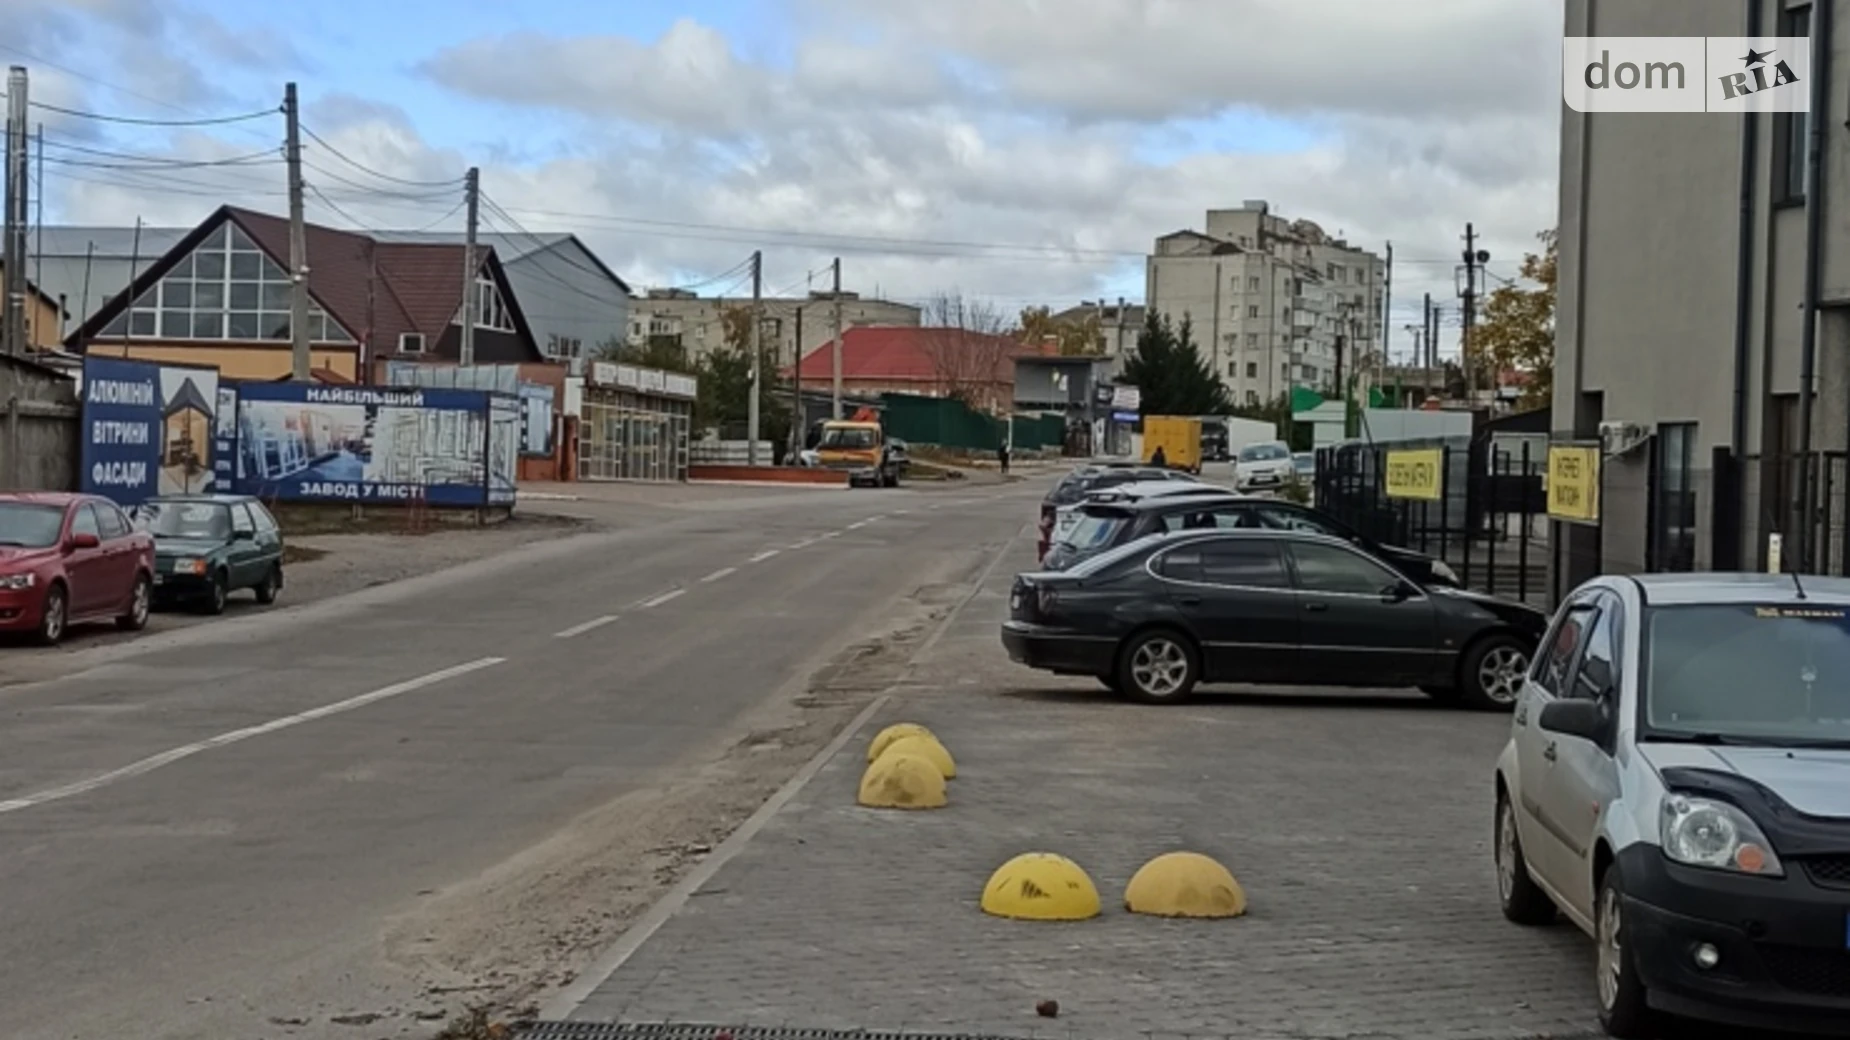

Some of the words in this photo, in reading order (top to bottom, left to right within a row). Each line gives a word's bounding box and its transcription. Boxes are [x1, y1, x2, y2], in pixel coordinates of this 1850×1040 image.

[307, 387, 424, 406] НАЙБІЛЬШИЙ
[92, 420, 149, 444] ВІТРИНИ
[92, 461, 147, 488] ФАСАДИ
[300, 481, 359, 499] ЗАВОД
[362, 484, 374, 497] У
